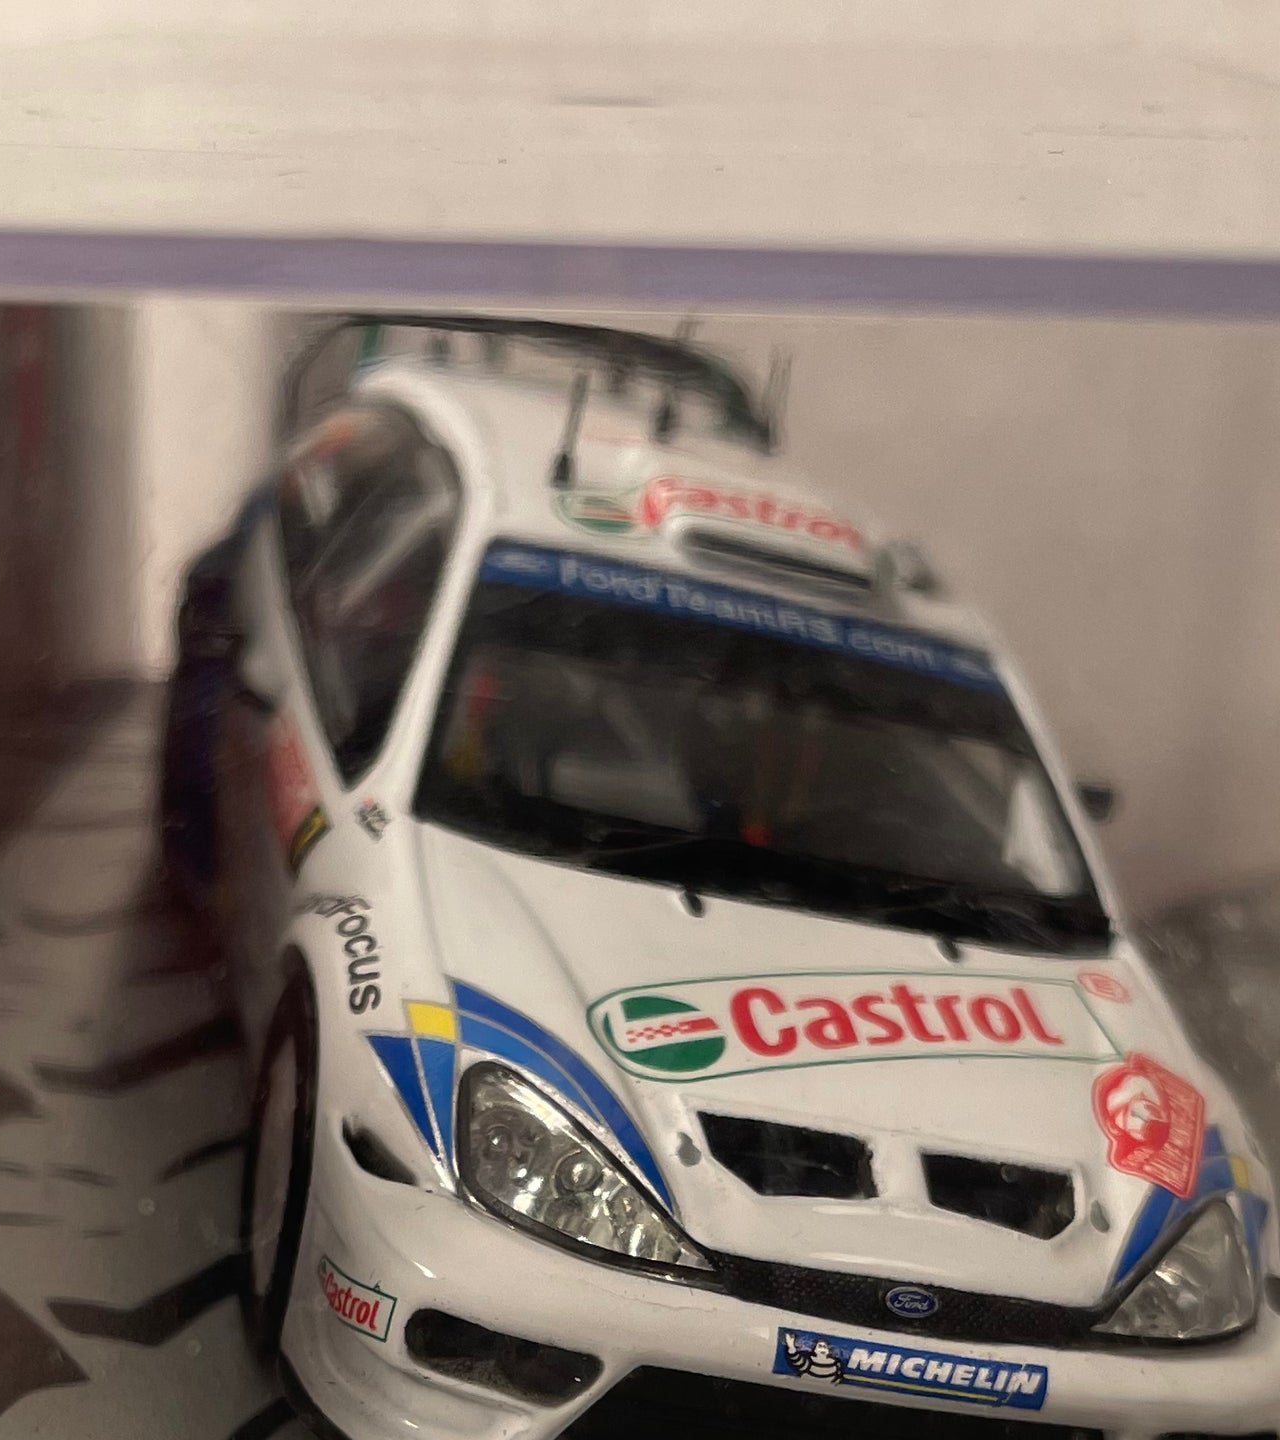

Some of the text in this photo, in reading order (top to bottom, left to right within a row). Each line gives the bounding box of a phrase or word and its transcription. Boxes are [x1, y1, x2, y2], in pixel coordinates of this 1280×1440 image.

[729, 983, 1066, 1058] Castrol
[324, 1271, 380, 1331] Castrol
[846, 1347, 1044, 1395] MICHELIN
